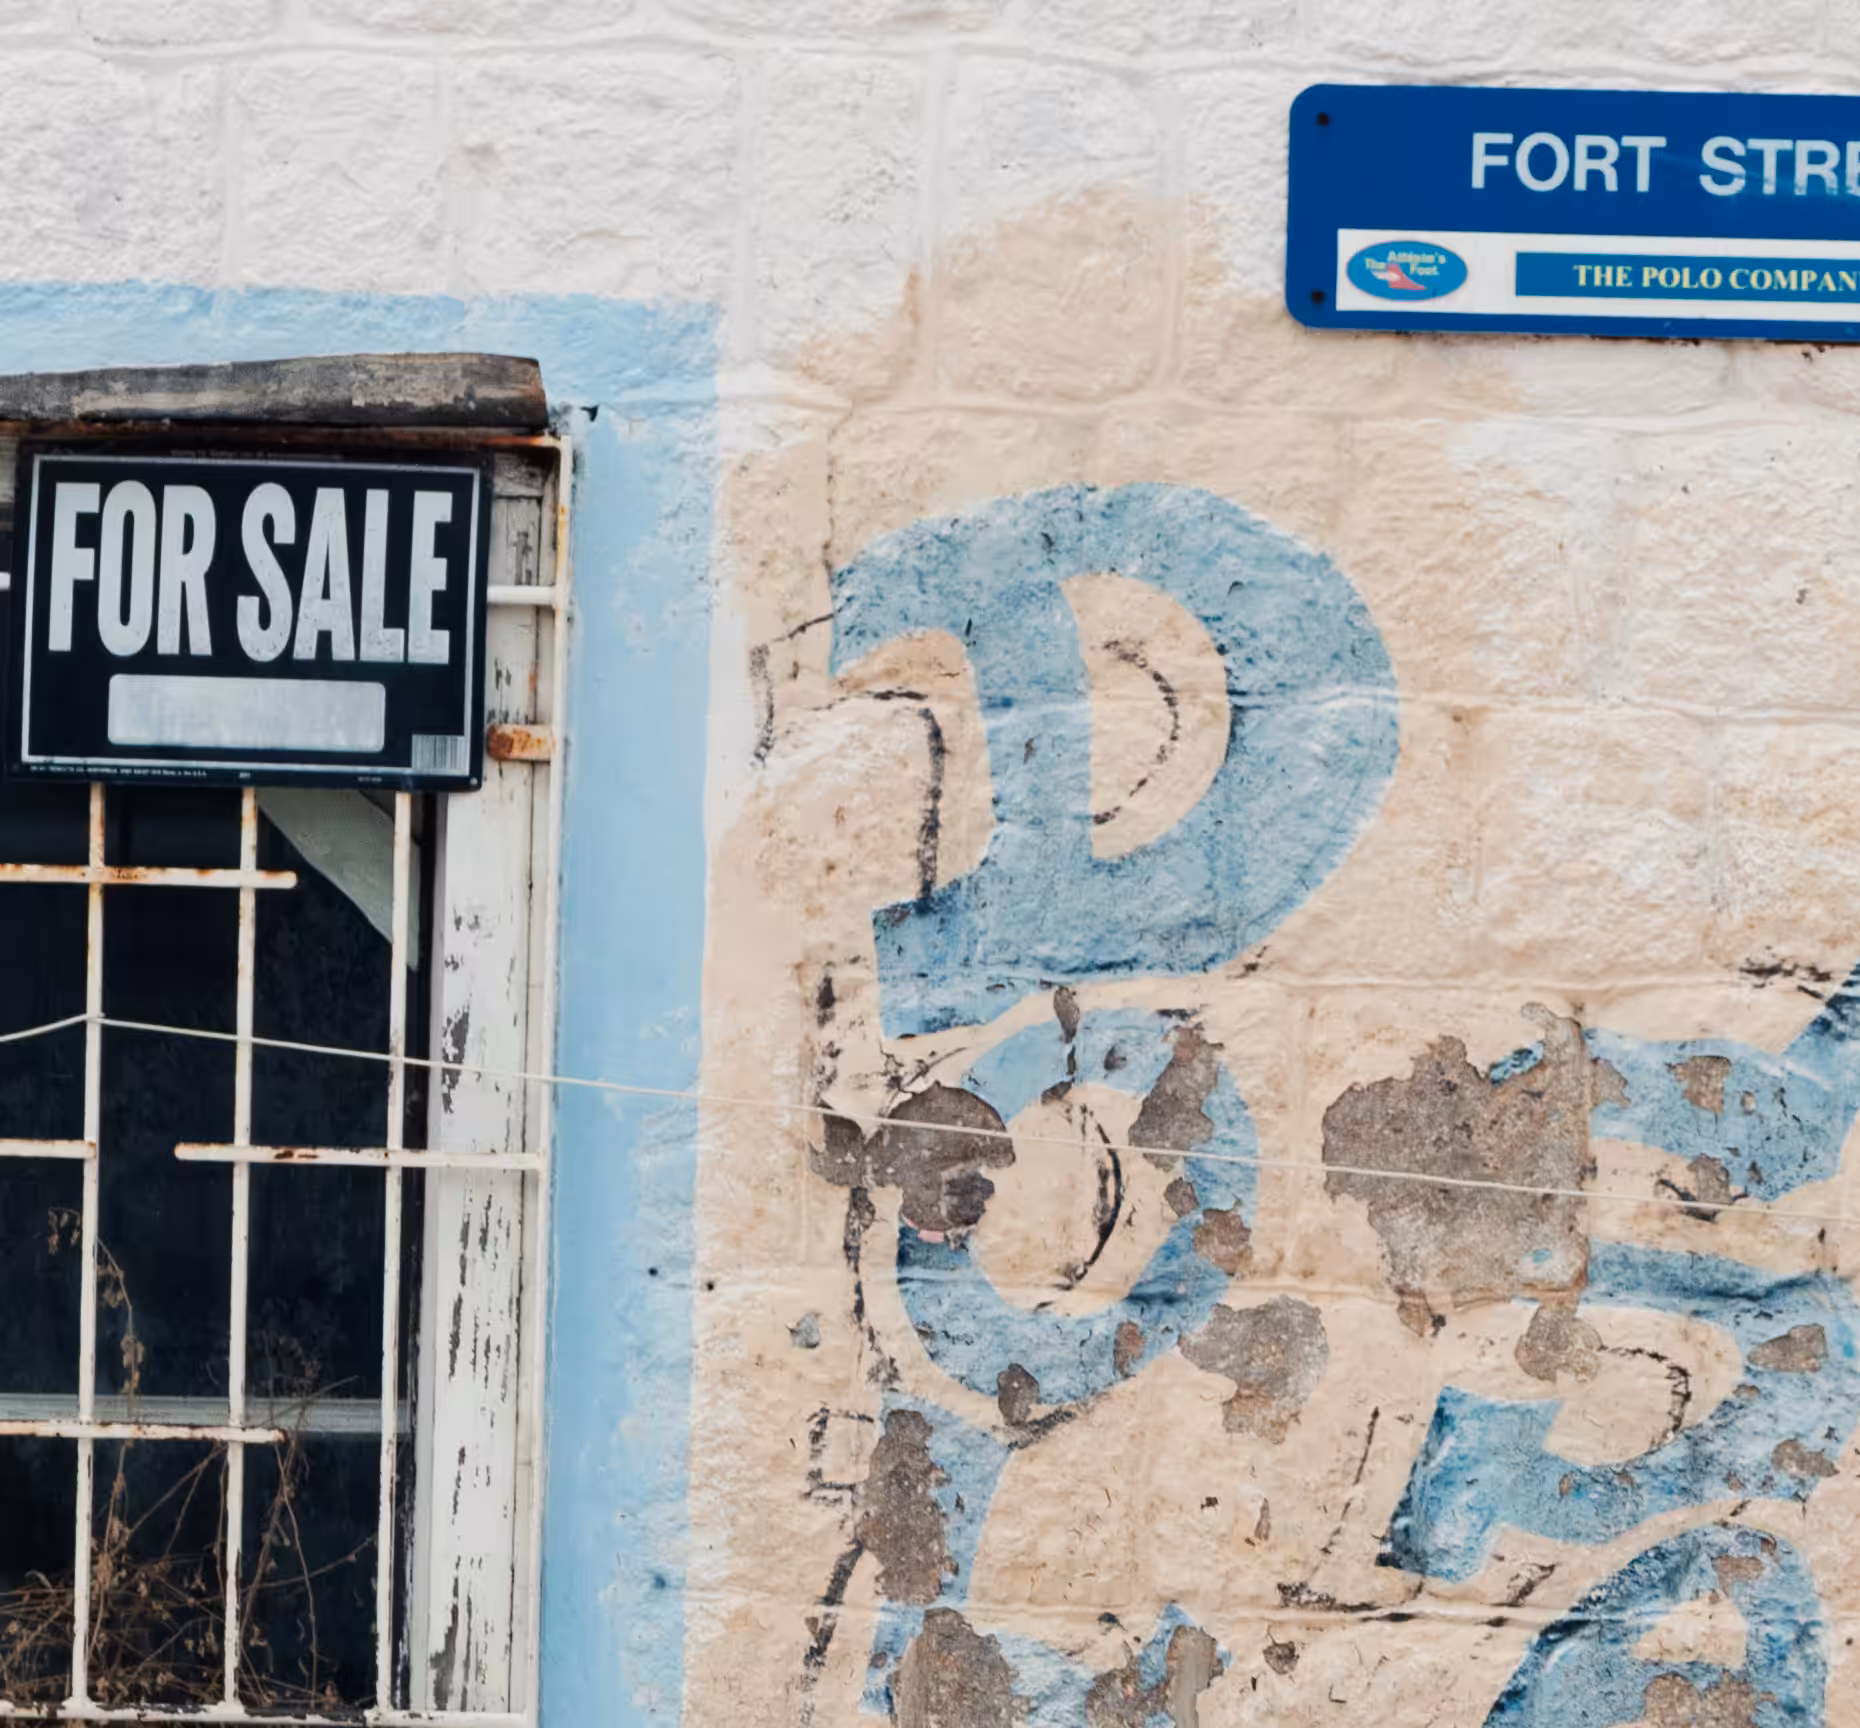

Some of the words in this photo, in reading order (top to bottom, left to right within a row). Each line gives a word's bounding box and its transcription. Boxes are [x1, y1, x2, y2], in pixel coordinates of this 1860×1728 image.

[1471, 131, 1667, 193] FORT
[1573, 264, 1633, 287] THE
[1641, 266, 1722, 290] POLO
[48, 480, 217, 657] FOR
[236, 482, 453, 665] SALE
